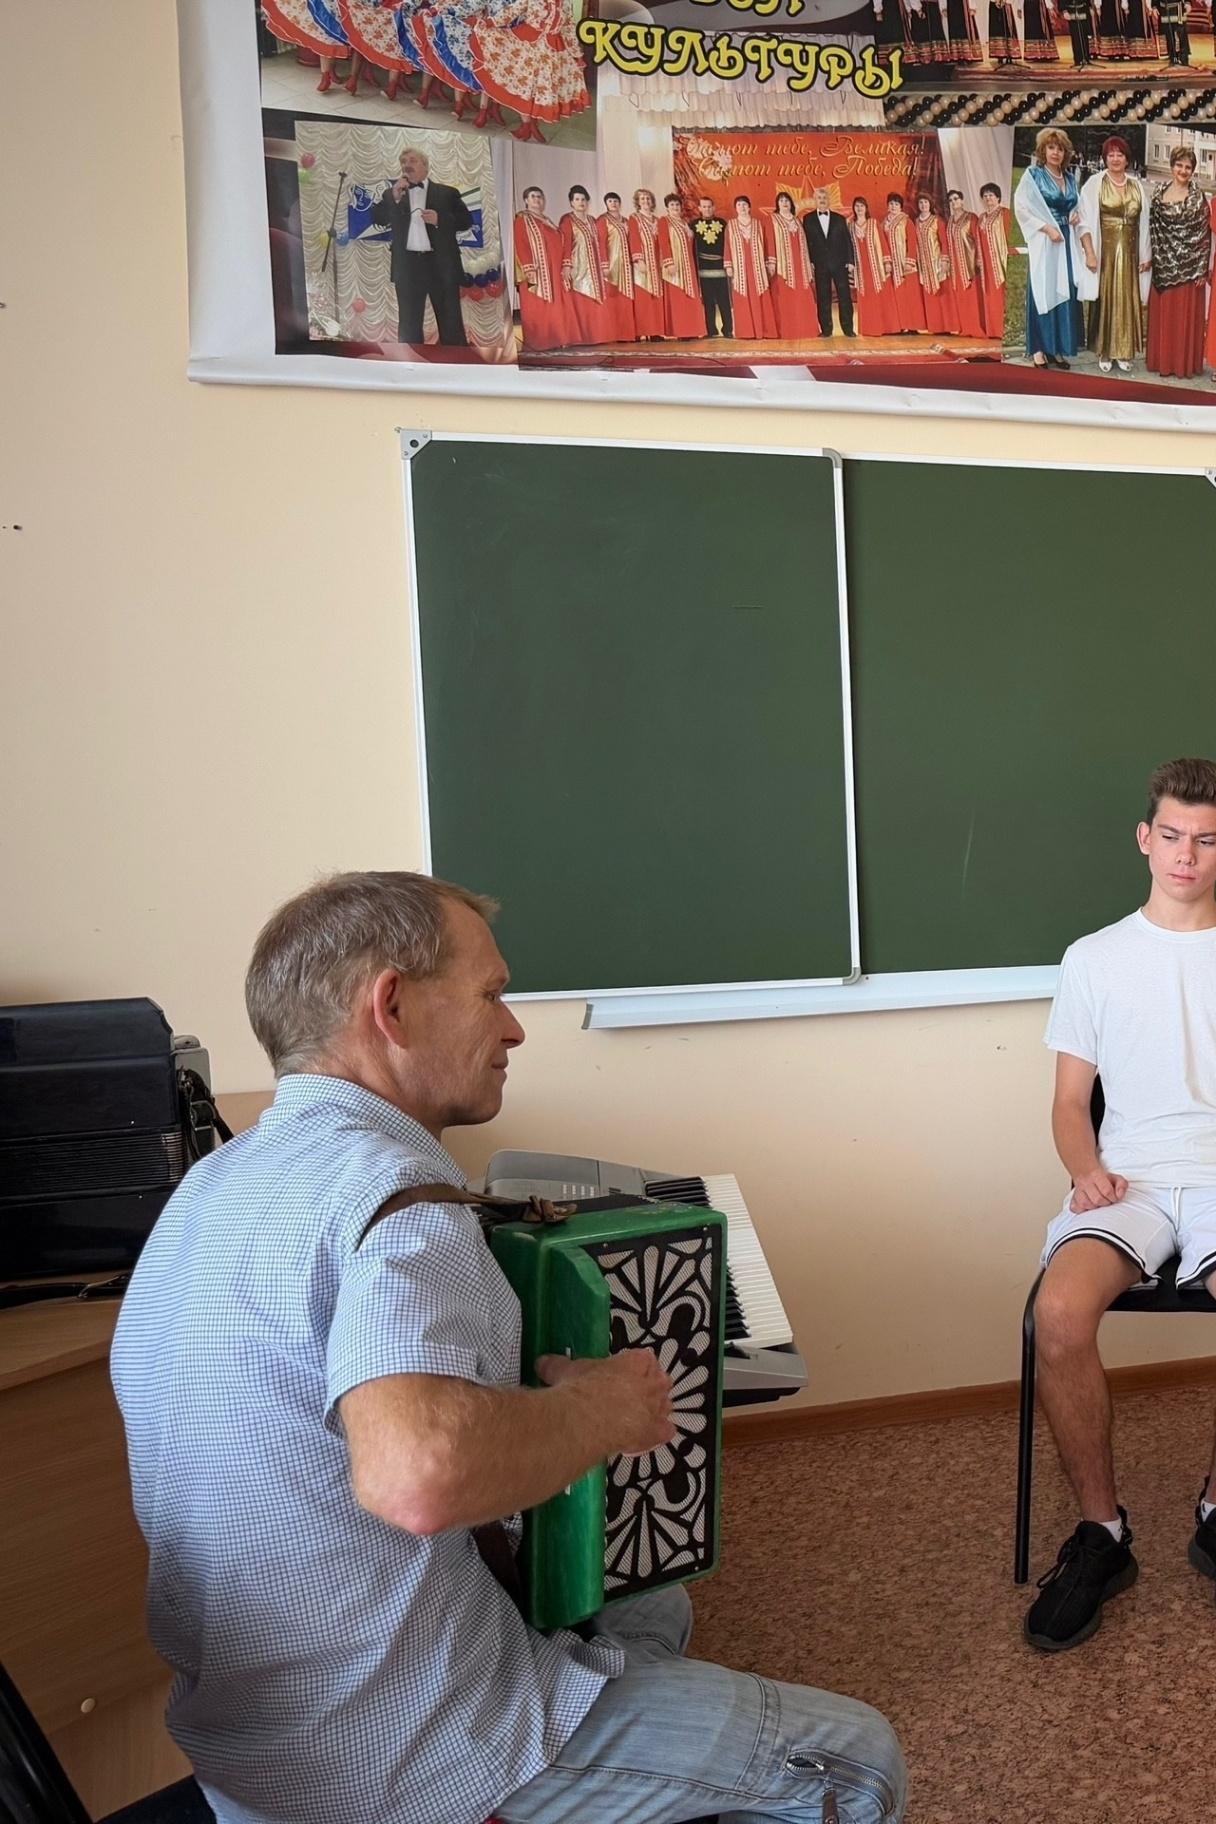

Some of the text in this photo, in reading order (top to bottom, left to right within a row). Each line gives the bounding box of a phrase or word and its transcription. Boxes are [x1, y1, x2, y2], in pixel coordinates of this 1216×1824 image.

[577, 17, 904, 98] КУЛЬТУРЫ
[765, 137, 812, 157] тебе,
[820, 135, 925, 157] Великая!
[777, 157, 826, 177] тебе,
[832, 155, 918, 179] Победа!
